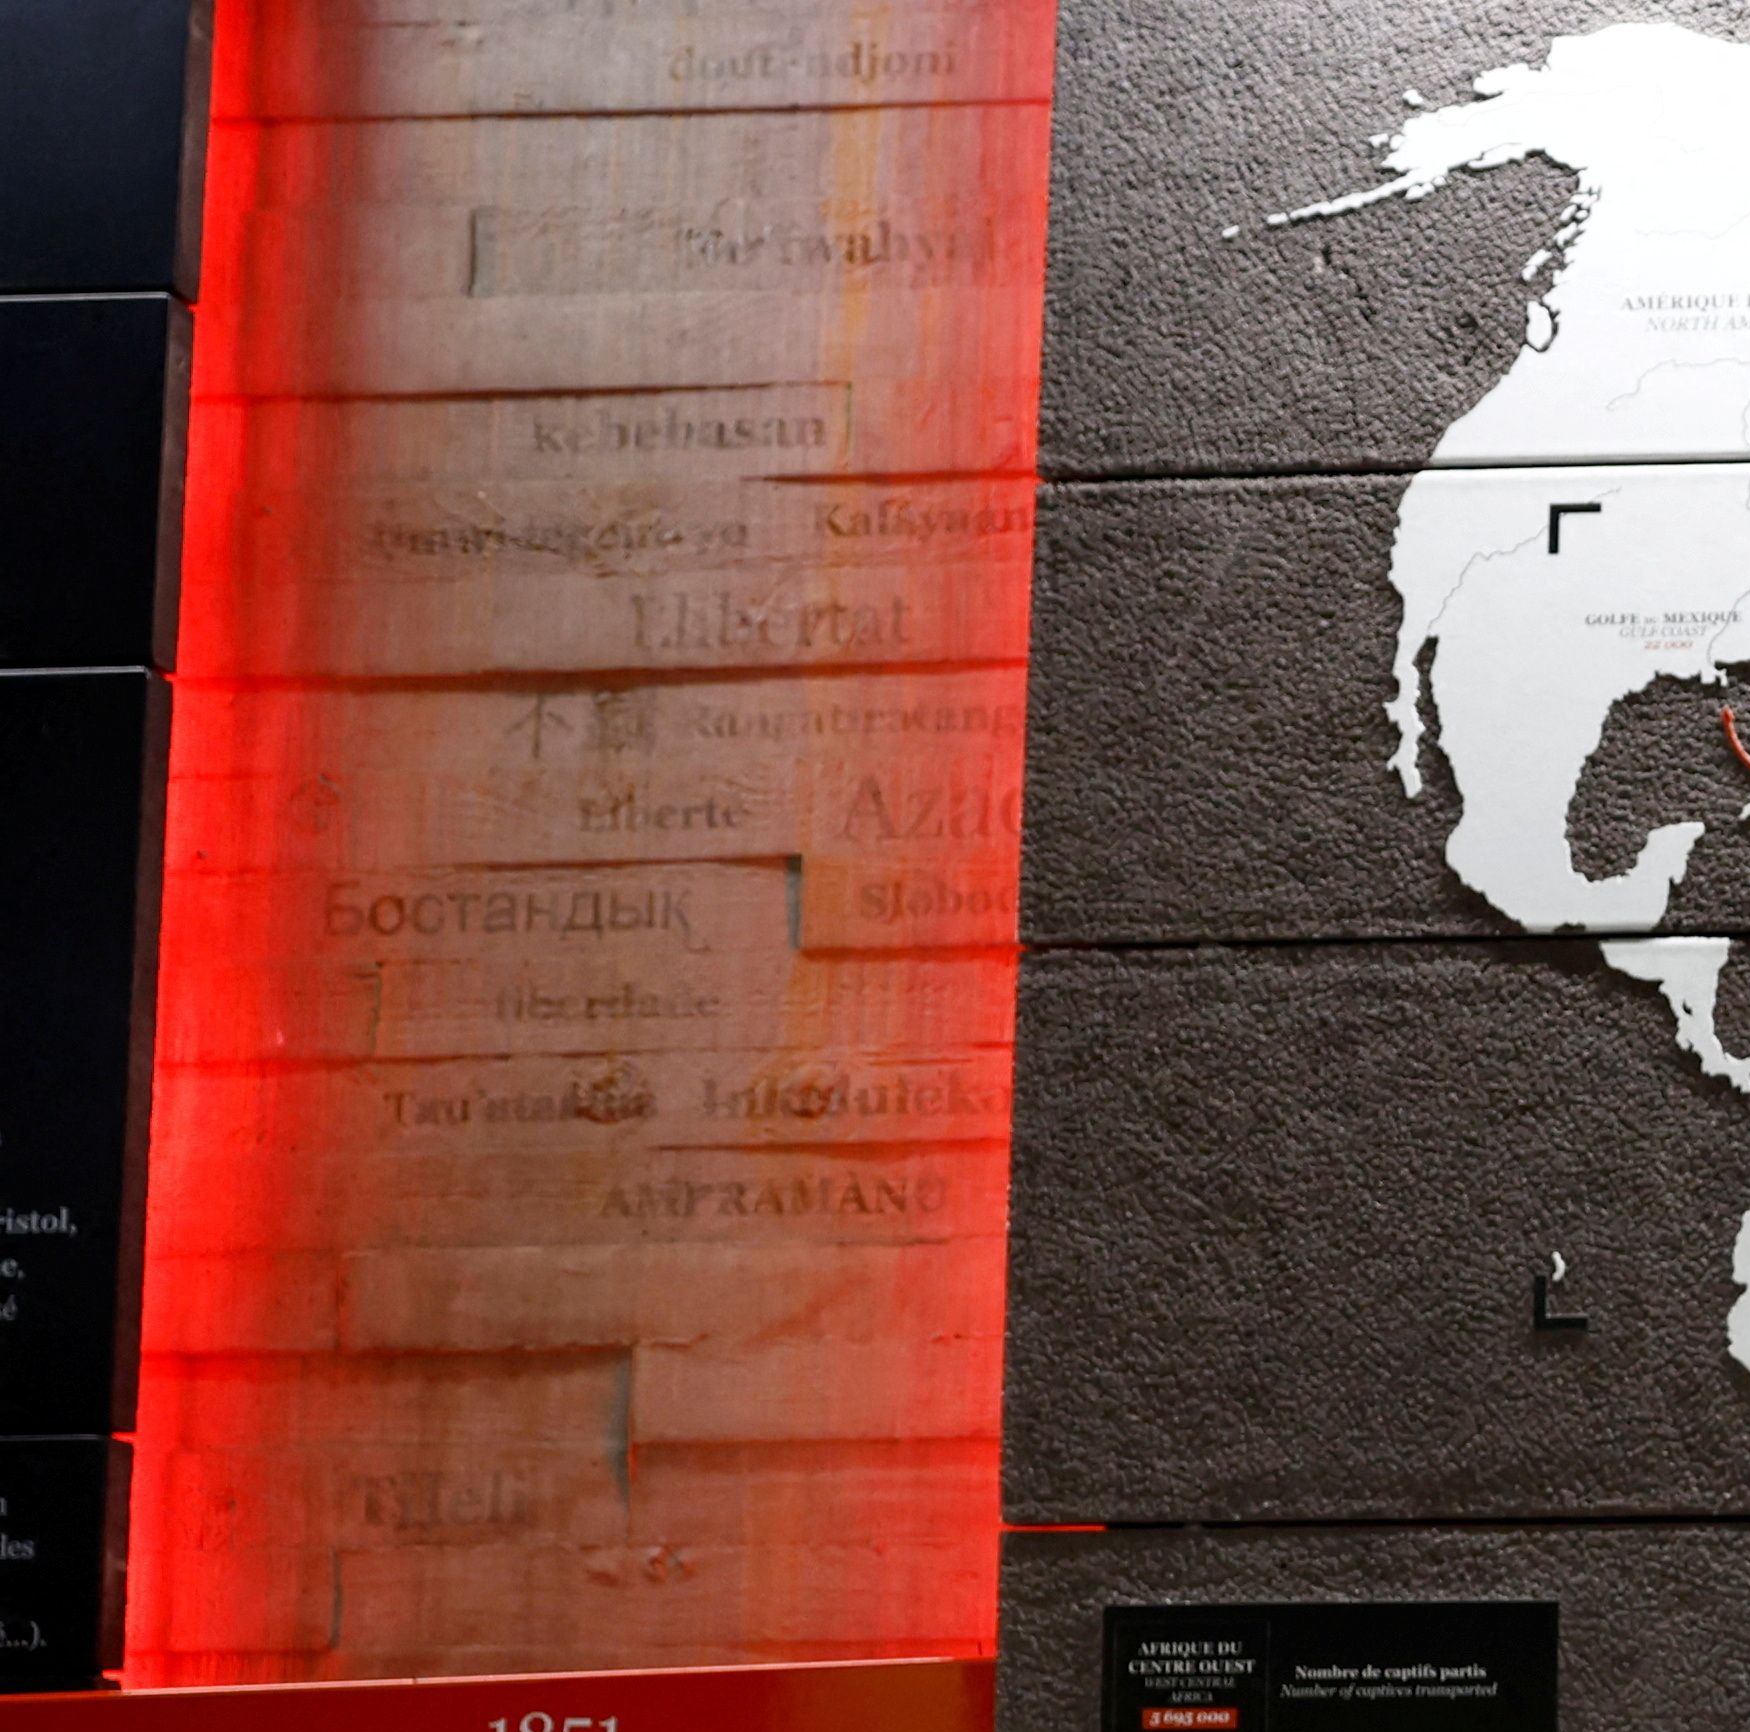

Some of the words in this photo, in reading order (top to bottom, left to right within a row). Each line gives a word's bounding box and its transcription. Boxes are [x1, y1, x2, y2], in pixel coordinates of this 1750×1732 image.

[1621, 293, 1741, 312] AMÉRIQUE
[1645, 316, 1718, 332] NORTH
[1585, 613, 1640, 626] GOLFE
[1663, 611, 1742, 626] MEXIQUE
[1138, 1641, 1214, 1657] AFRIQUE
[1217, 1641, 1243, 1656] DU
[1128, 1659, 1197, 1675] CENTRE
[1198, 1658, 1256, 1674] OUEST
[1295, 1664, 1358, 1680] Nombre
[1361, 1664, 1380, 1680] de
[1383, 1663, 1436, 1682] captifs
[1439, 1663, 1487, 1682] partis
[1280, 1683, 1337, 1699] Number
[1339, 1682, 1354, 1700] of
[1355, 1682, 1413, 1700] captives
[1415, 1682, 1498, 1699] transported
